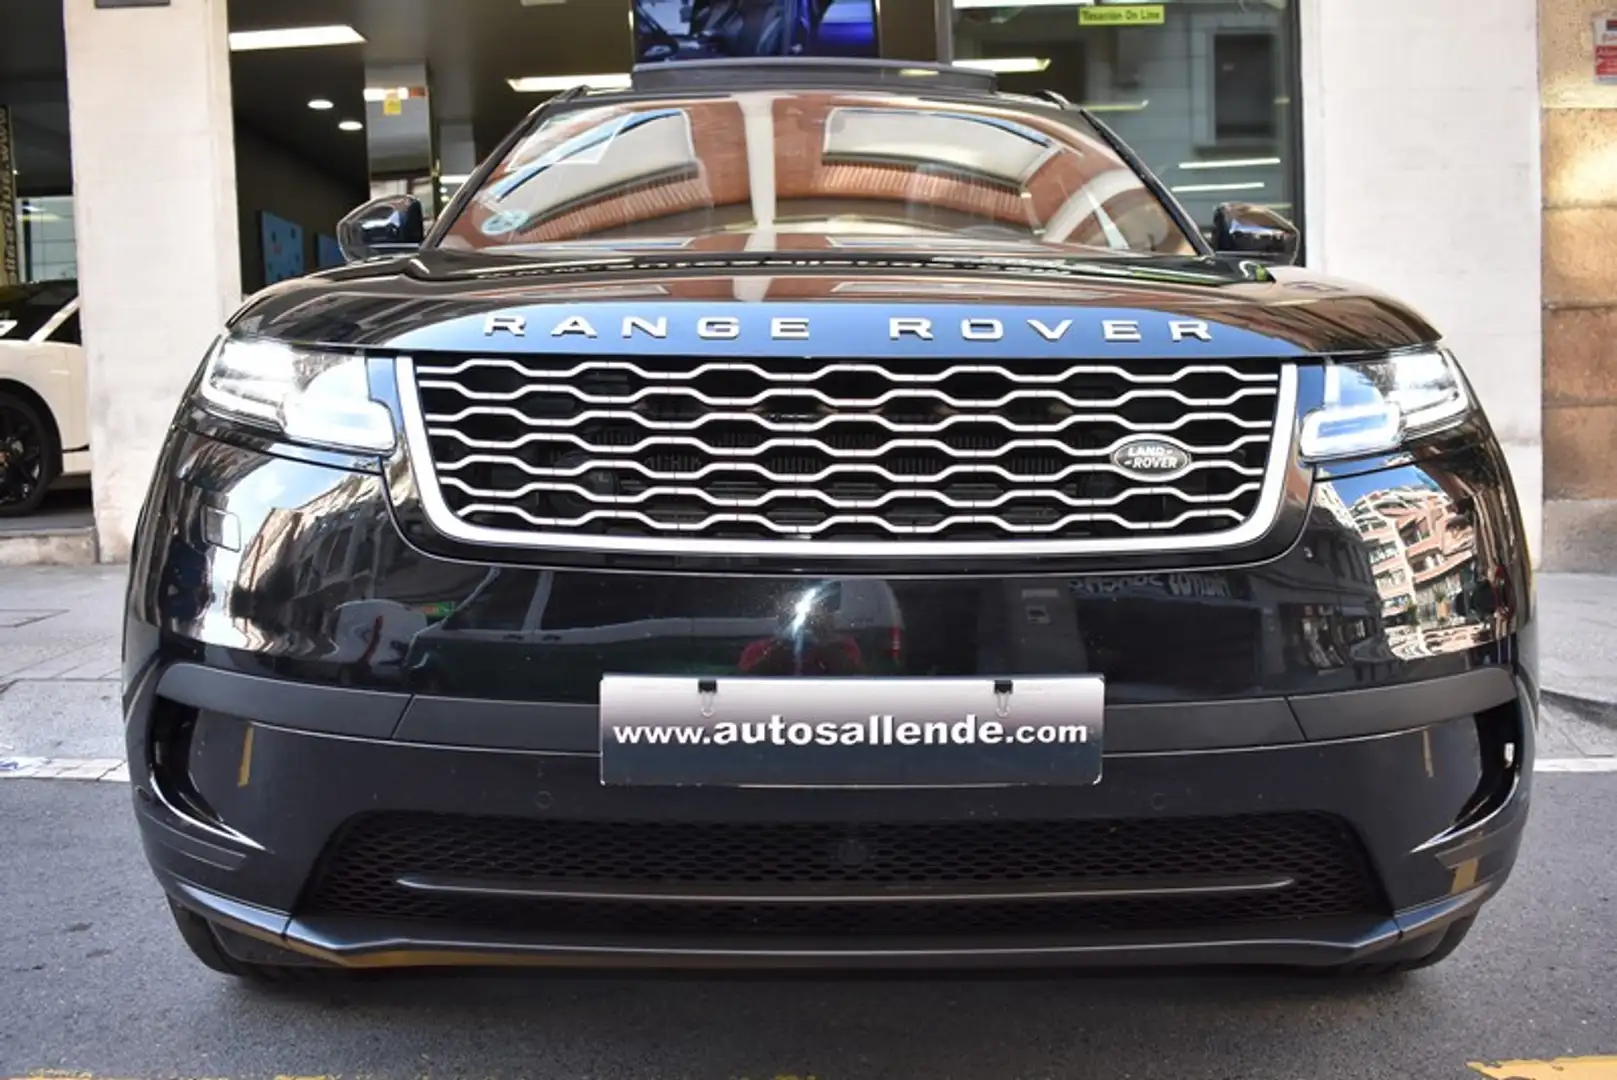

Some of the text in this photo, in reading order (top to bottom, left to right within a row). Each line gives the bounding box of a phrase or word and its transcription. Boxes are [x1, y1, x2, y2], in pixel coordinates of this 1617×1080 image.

[484, 315, 1212, 342] RANGE ROVER
[612, 714, 1088, 746] www.autosallende.com
